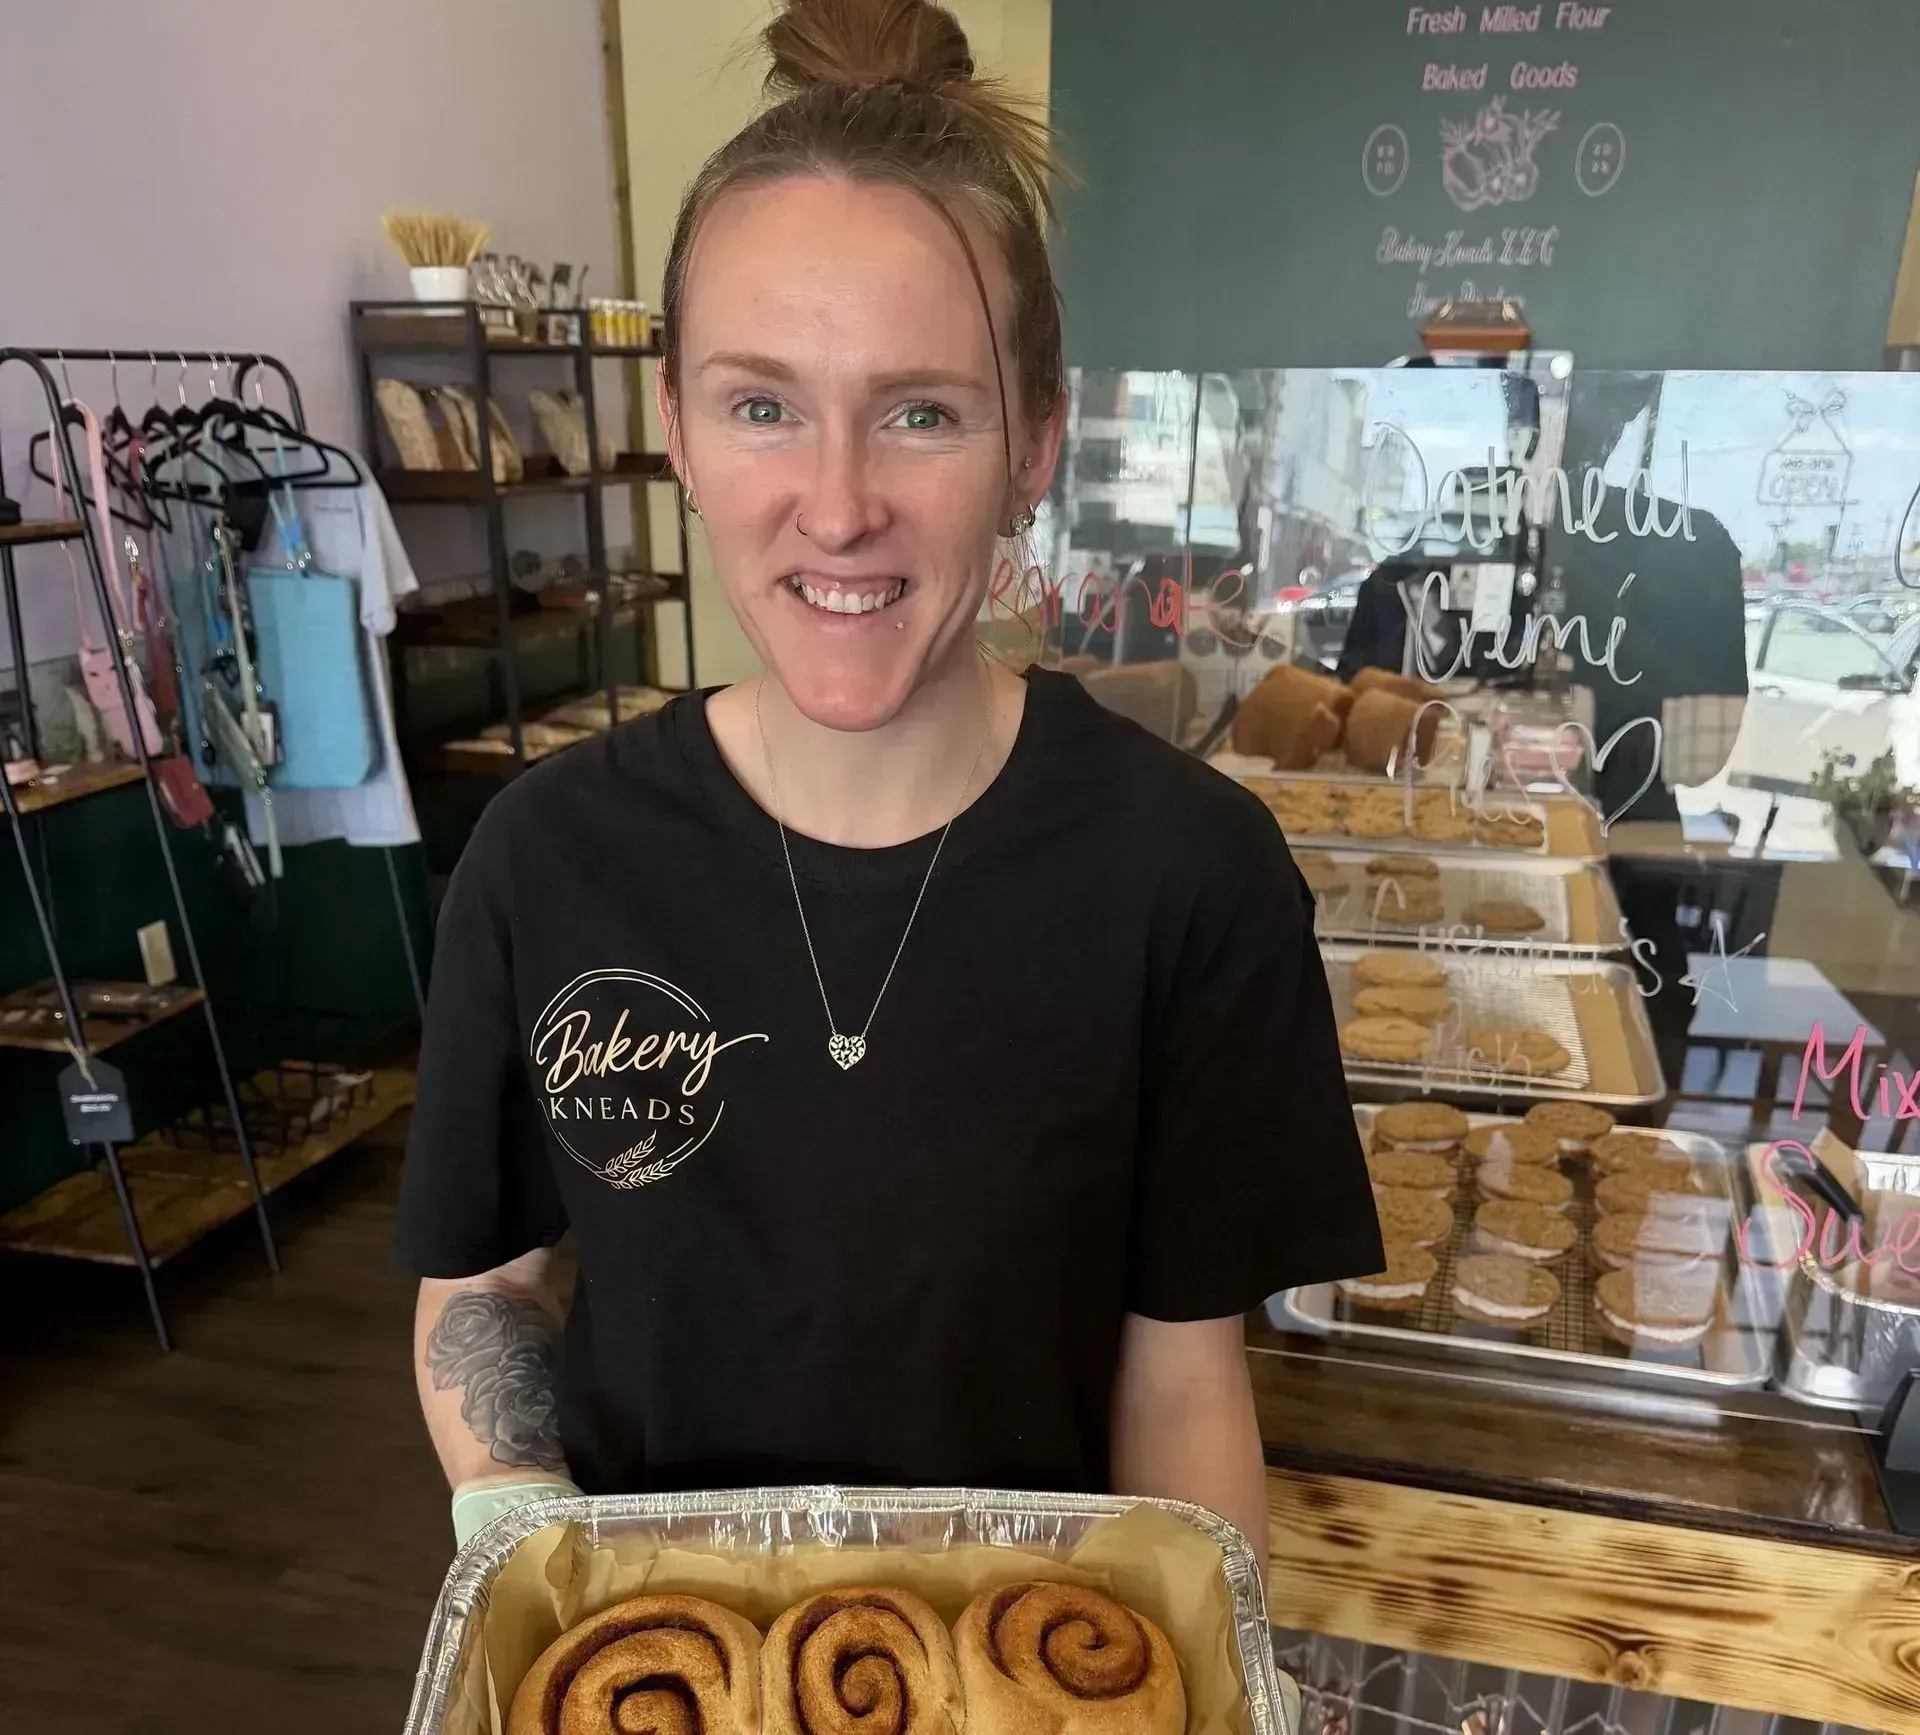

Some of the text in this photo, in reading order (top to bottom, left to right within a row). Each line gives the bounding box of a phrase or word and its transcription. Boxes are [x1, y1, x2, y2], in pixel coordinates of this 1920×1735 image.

[1406, 1, 1612, 35] Fresh Milled Flour
[1422, 60, 1578, 91] Baked Goods
[1361, 420, 1698, 555] Oatmeal
[536, 1008, 769, 1097] Bakery
[550, 1096, 696, 1126] KNEADS
